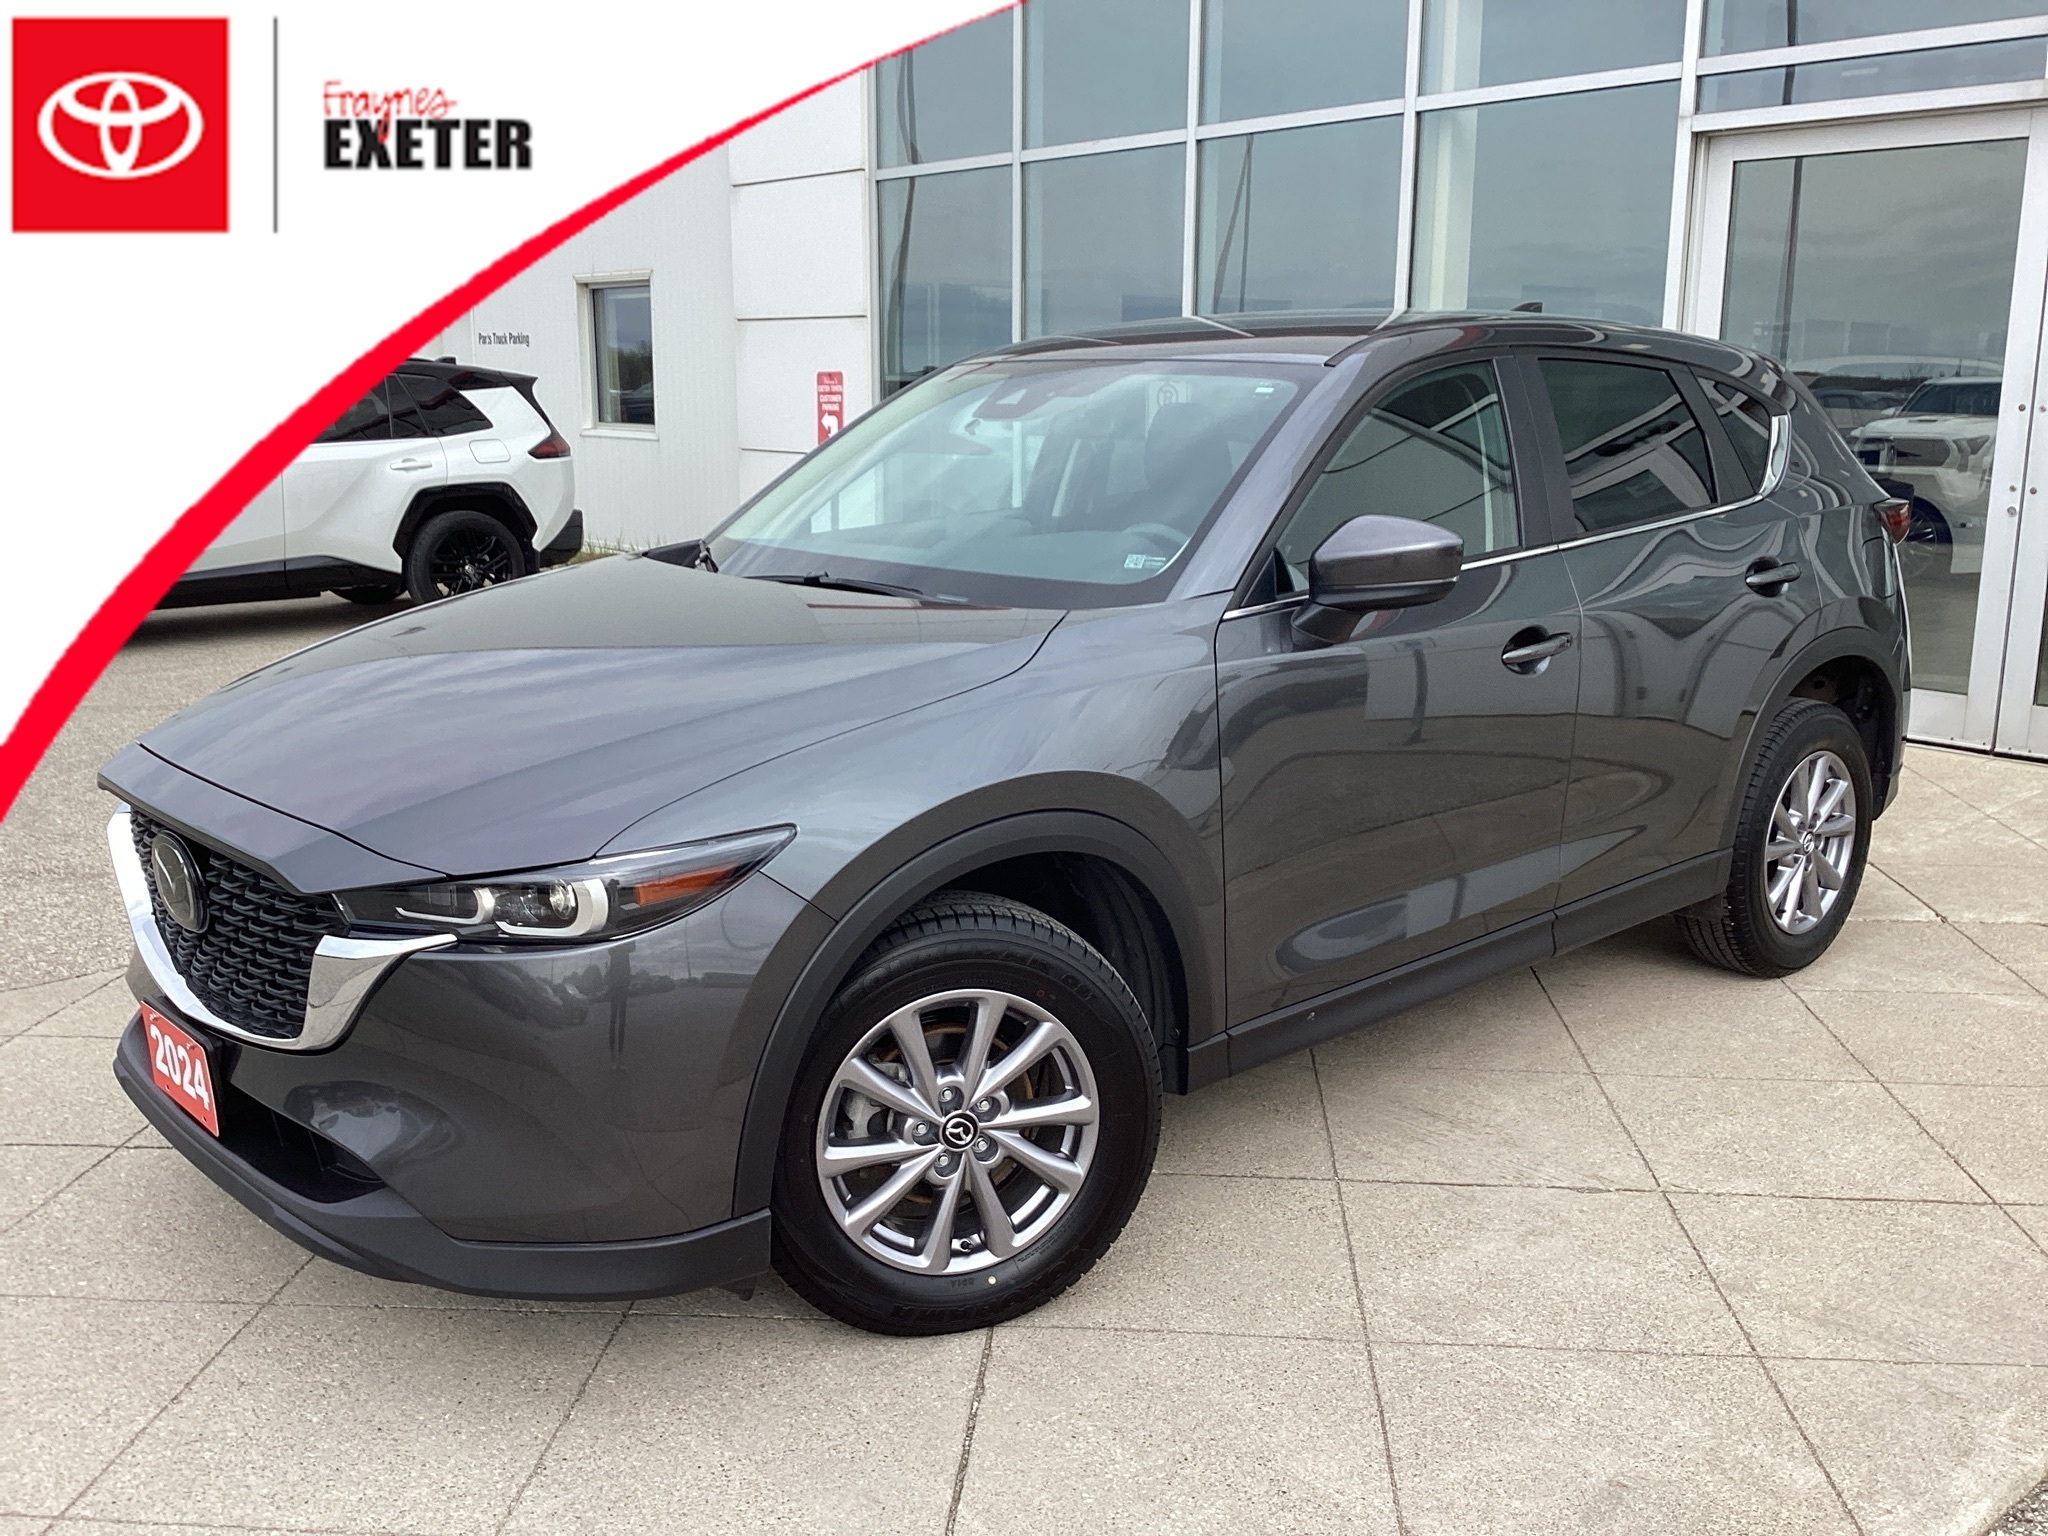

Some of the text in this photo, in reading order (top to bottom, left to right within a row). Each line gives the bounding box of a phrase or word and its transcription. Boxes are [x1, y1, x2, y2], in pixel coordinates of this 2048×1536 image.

[492, 332, 508, 345] Truck
[508, 331, 530, 348] Parking
[150, 1023, 209, 1111] 2024
